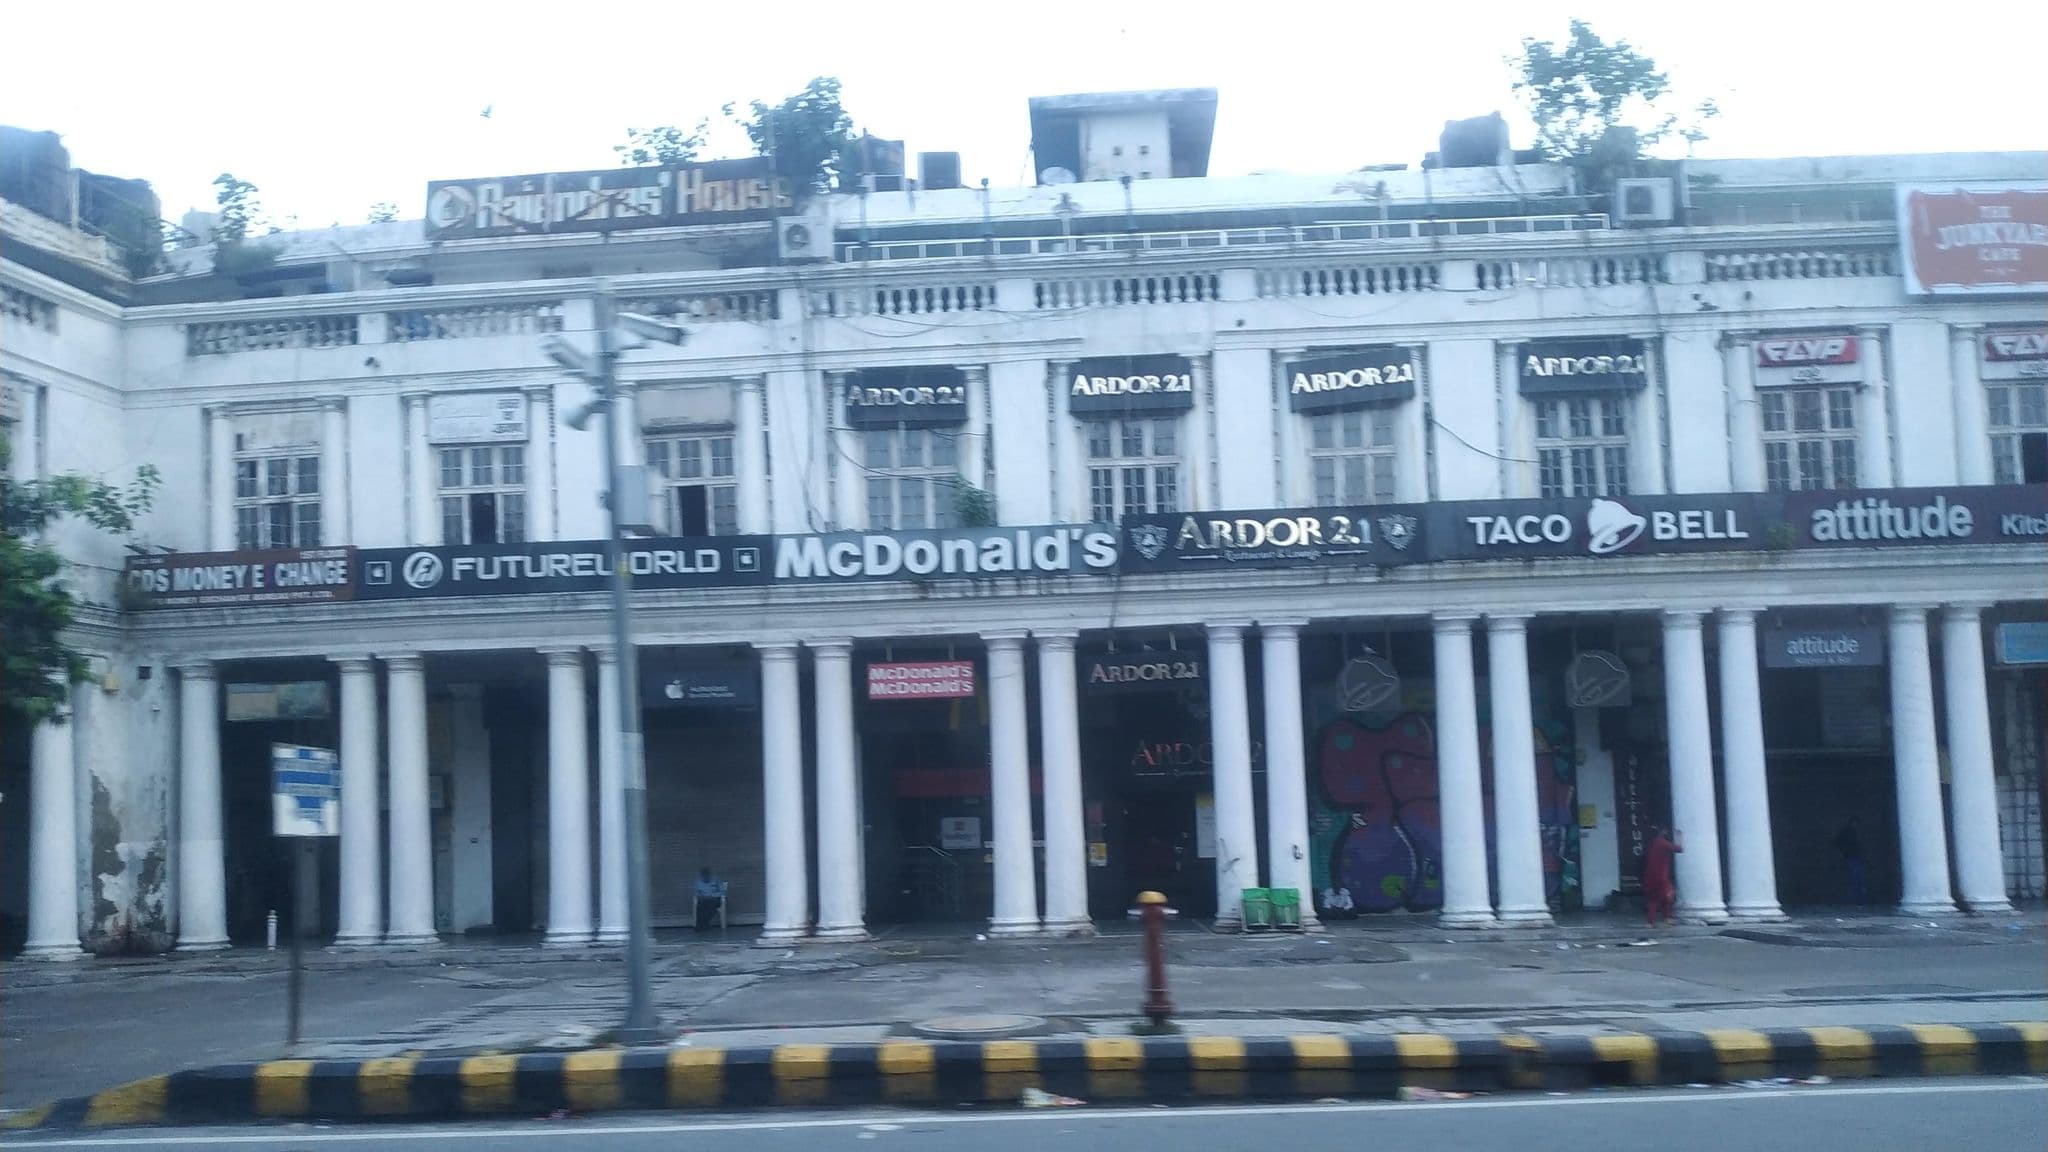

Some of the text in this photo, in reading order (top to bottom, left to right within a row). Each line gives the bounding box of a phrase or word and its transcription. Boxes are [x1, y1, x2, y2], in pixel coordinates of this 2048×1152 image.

[1522, 355, 1617, 377] ARDOR
[1071, 374, 1164, 396] ARDOR
[1291, 367, 1385, 394] ARDOR
[846, 386, 937, 406] ARDOR
[1467, 510, 1750, 545] TACO BELL
[1811, 495, 1974, 542] attitude
[1174, 515, 1327, 550] ARDOR
[774, 528, 1118, 579] McDonald's
[173, 565, 248, 591] MONEY
[1785, 631, 1860, 655] attitude
[868, 665, 974, 680] McDonald's
[1089, 663, 1172, 683] ARDOR
[869, 680, 975, 695] McDonald's
